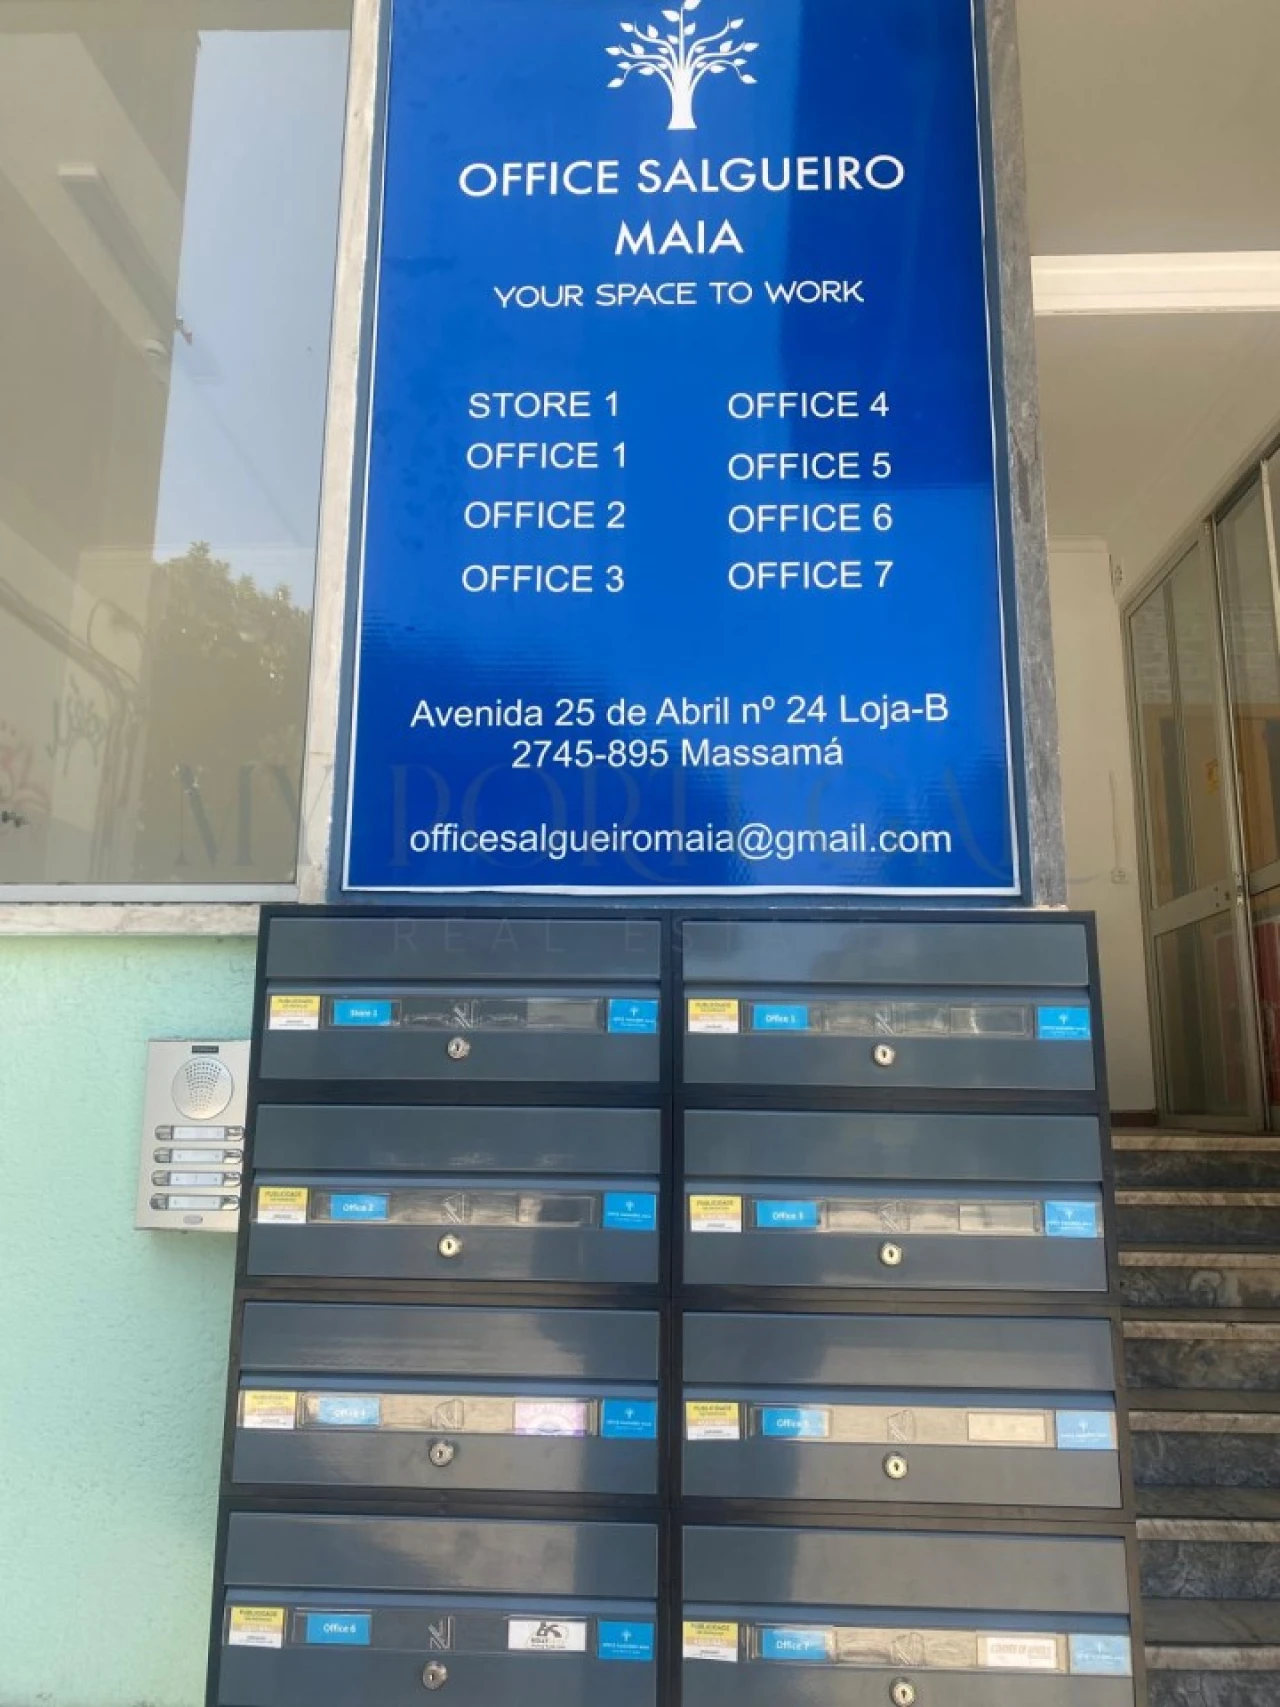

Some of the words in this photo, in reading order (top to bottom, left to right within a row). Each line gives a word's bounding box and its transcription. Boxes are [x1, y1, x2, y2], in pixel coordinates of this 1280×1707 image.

[459, 160, 618, 197] OFFICE
[638, 155, 904, 193] SALGUEIRO
[615, 219, 744, 255] MAIA
[494, 285, 584, 308] YOUR
[597, 283, 696, 307] SPACE
[709, 282, 753, 304] TO
[765, 281, 865, 304] WORK
[469, 392, 590, 418] STORE
[605, 392, 617, 417] 1
[729, 392, 858, 418] OFFICE
[871, 392, 889, 417] 4
[467, 443, 597, 469] OFFICE
[613, 443, 625, 467] 1
[729, 453, 859, 480] OFFICE
[873, 453, 891, 479] 5
[465, 502, 594, 529] OFFICE
[607, 501, 625, 528] 2
[729, 504, 860, 532] OFFICE
[874, 504, 893, 531] 6
[462, 565, 592, 593] OFFICE
[606, 565, 624, 592] 3
[729, 562, 861, 590] OFFICE
[875, 562, 893, 587] 7
[411, 700, 543, 728] Avenida
[555, 699, 595, 727] 25
[607, 699, 646, 726] de
[656, 697, 729, 725] Abril
[742, 697, 776, 724] nº
[787, 696, 828, 723] 24
[840, 694, 949, 730] Loja-B
[511, 740, 669, 768] 2745-895
[682, 737, 843, 767] Massamá
[410, 823, 952, 860] officesalgueiromaia@gmail.com
[322, 1622, 350, 1634] Office
